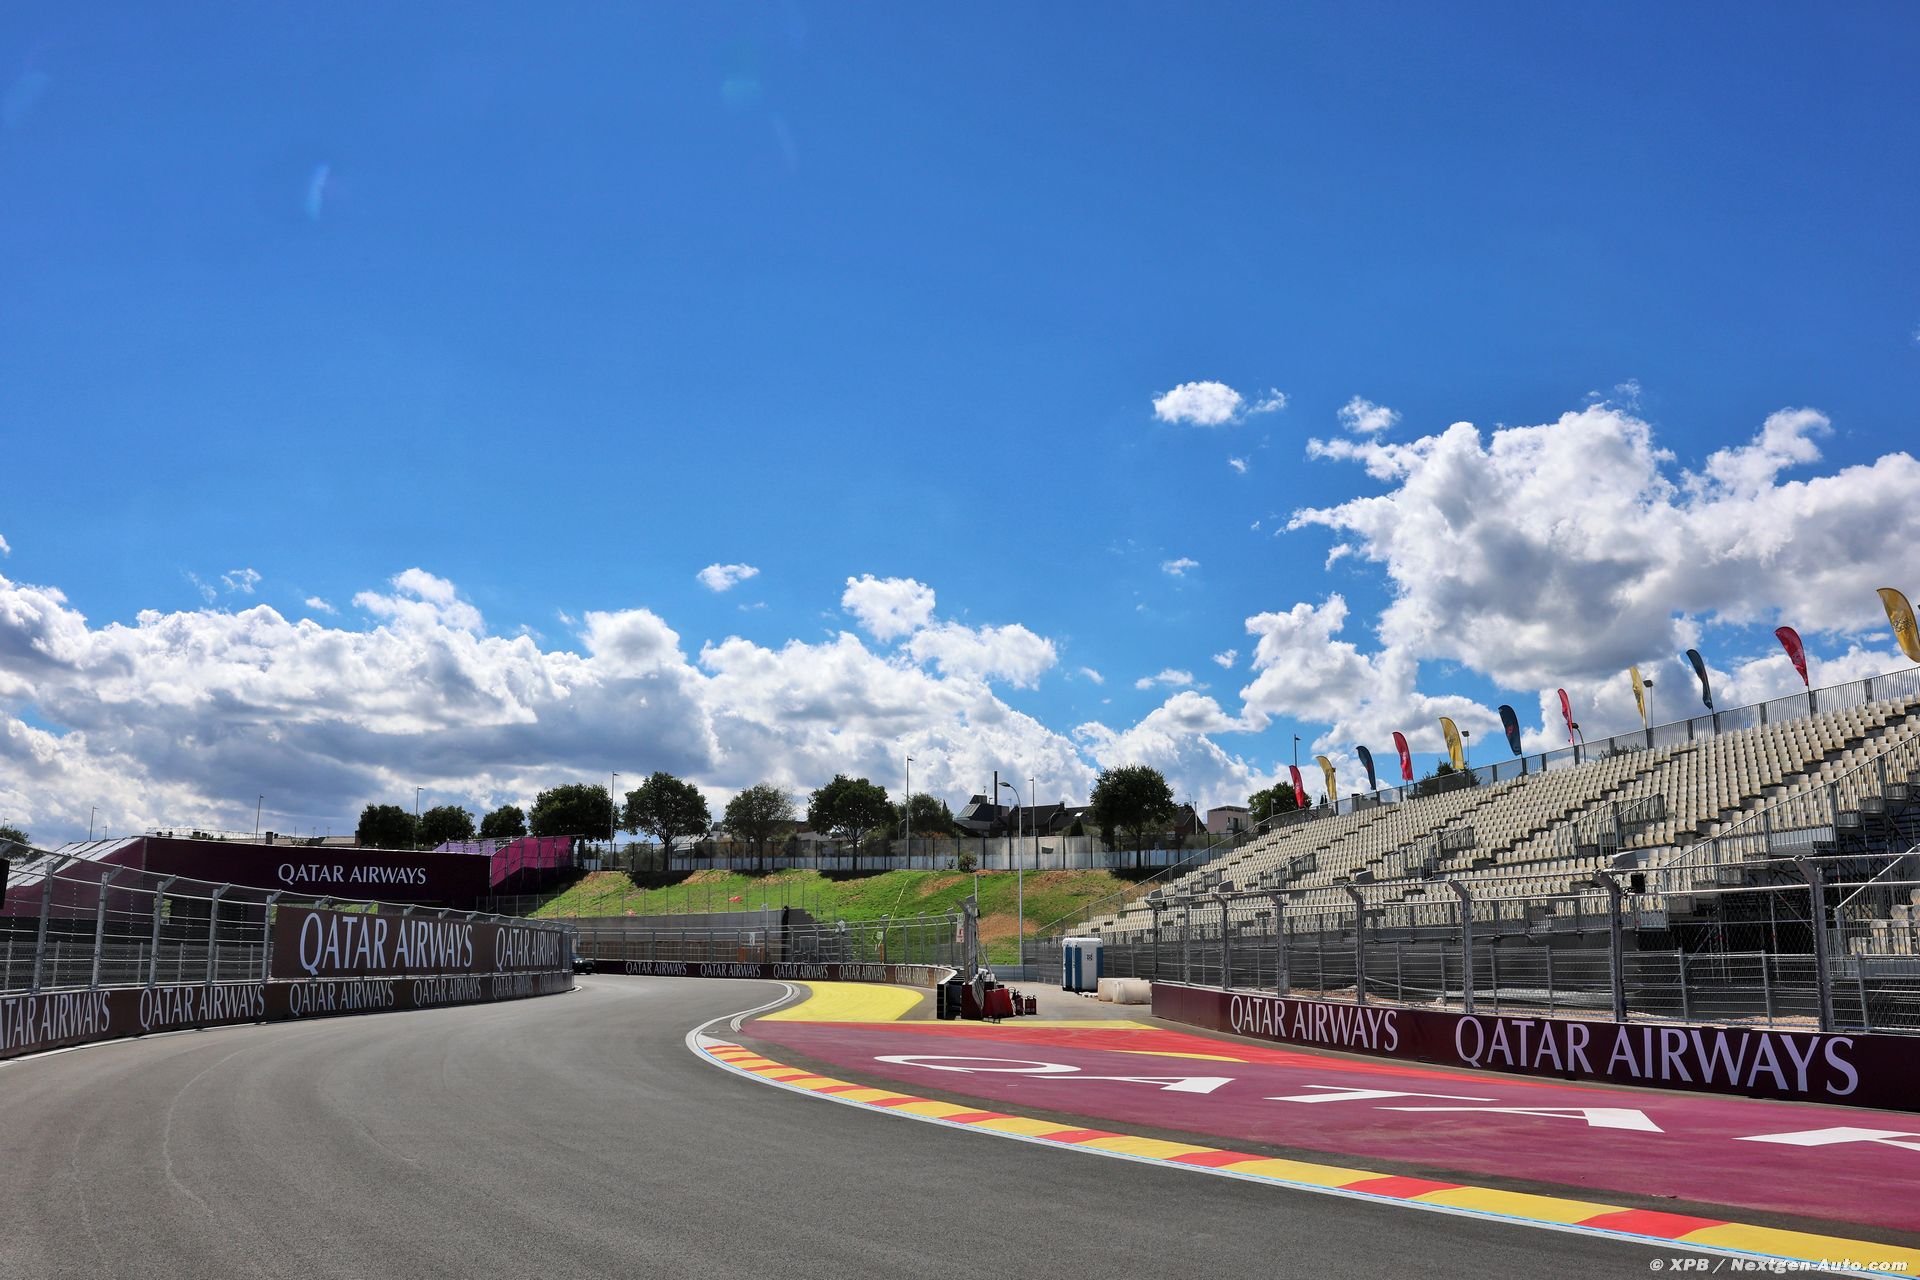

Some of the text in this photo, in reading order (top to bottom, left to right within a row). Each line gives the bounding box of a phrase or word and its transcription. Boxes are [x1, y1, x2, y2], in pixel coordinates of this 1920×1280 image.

[278, 863, 426, 885] QATAR AIRWAYS
[300, 912, 472, 976] QATAR AIRWAYS
[495, 927, 560, 971] QATAR AIRWAYS
[625, 961, 687, 975] QATAR AIRWAYS
[700, 963, 761, 977] QATAR AIRWAYS
[773, 964, 829, 979] QATAR AIRWAYS
[838, 965, 887, 981] QATAR AIRWAYS
[289, 981, 394, 1016] QATAR AIRWAYS
[413, 977, 482, 1006] QATAR AIRWAYS
[492, 976, 512, 999] QATAR
[0, 991, 111, 1050] TAR AIRWAYS
[139, 984, 265, 1030] QATAR AIRWAYS
[1230, 995, 1399, 1052] QATAR AIRWAYS
[1455, 1015, 1860, 1096] QATAR AIRWAYS
